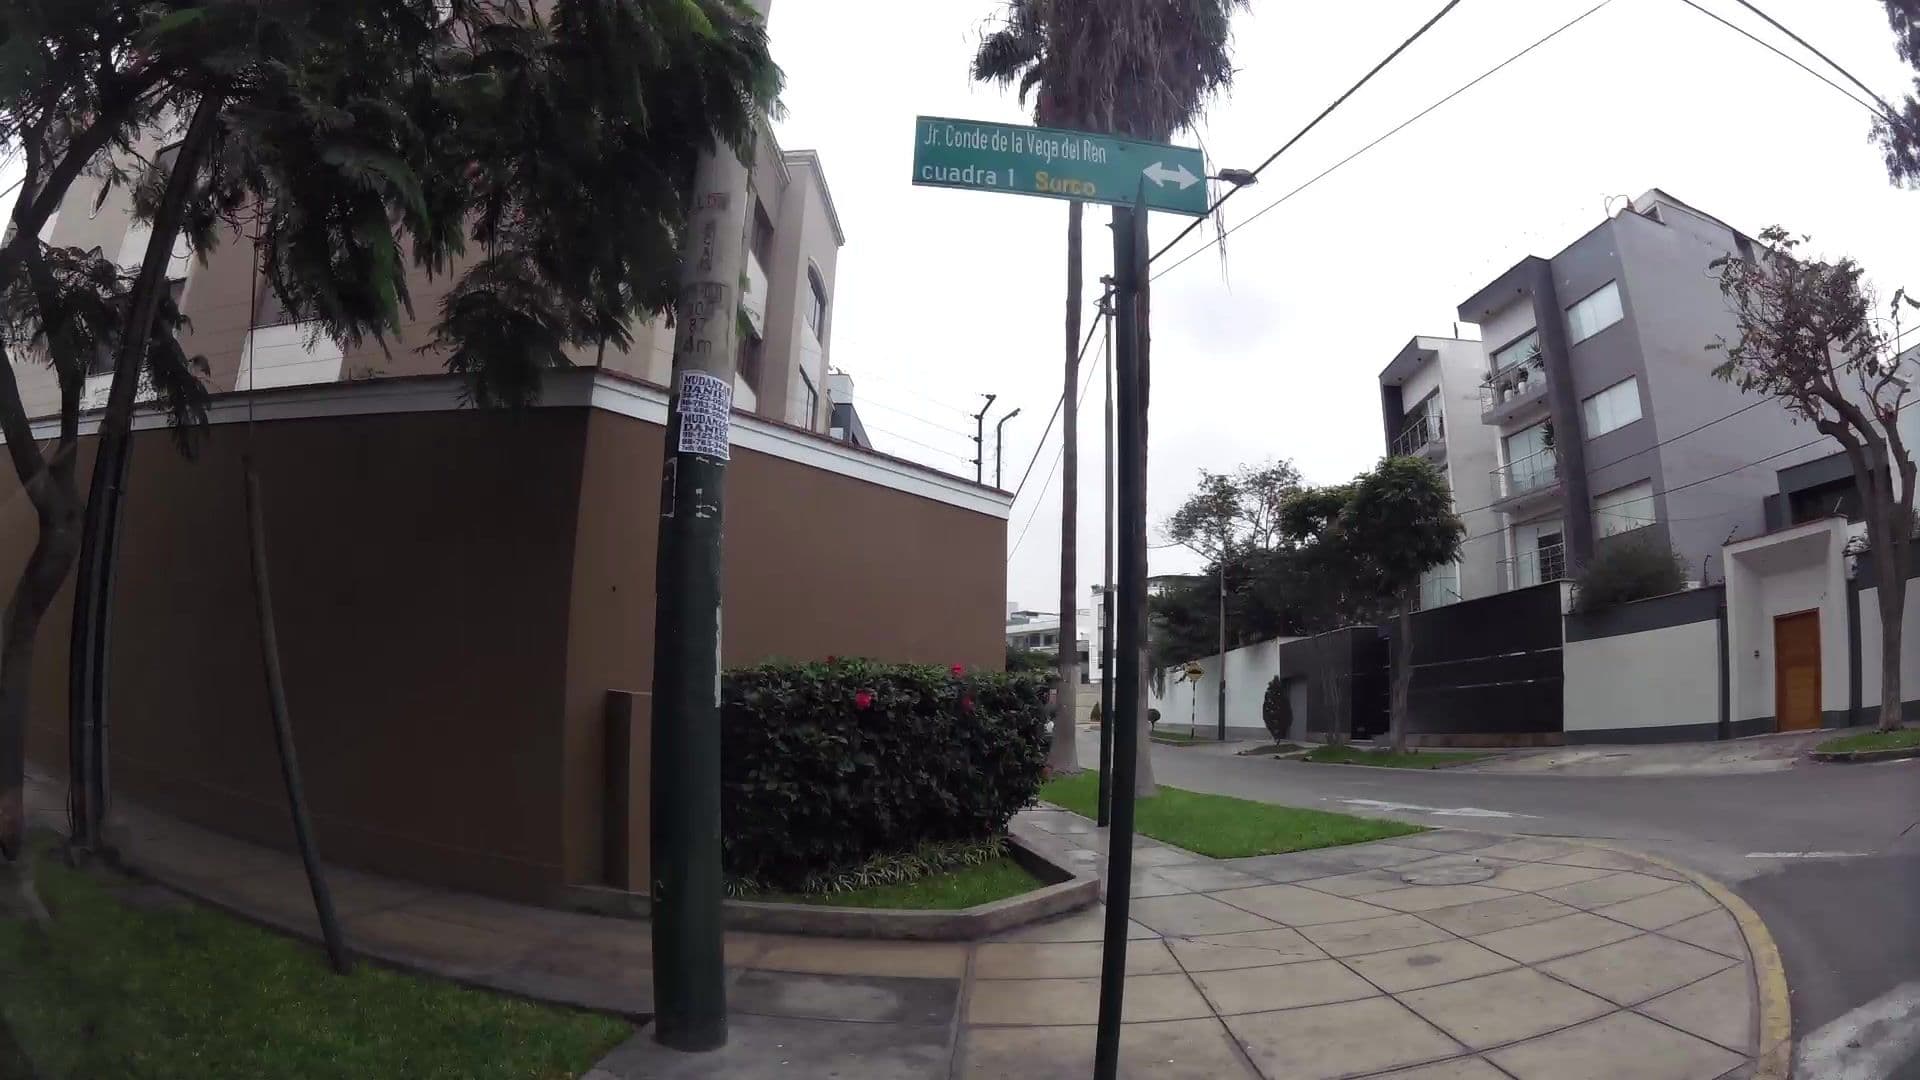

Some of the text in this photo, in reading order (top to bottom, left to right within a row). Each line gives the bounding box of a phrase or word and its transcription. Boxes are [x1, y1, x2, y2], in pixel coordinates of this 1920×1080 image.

[924, 123, 1106, 164] Jr. Conde de la Vega del Ren
[922, 163, 1097, 196] cuadra 1 Surco
